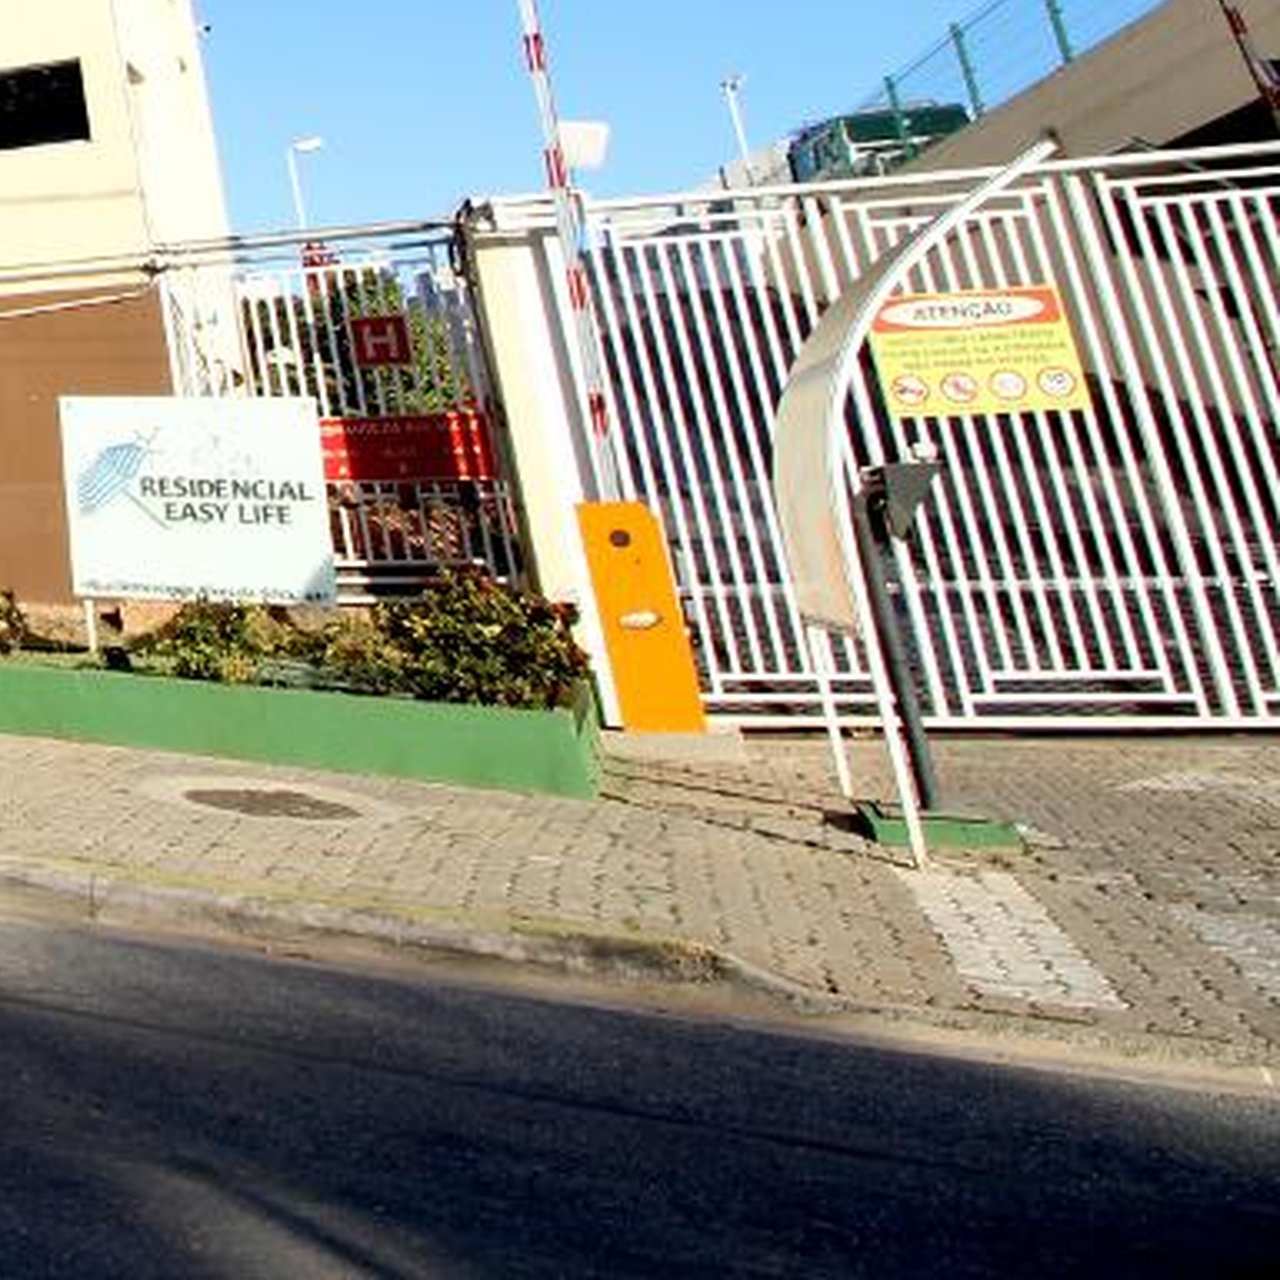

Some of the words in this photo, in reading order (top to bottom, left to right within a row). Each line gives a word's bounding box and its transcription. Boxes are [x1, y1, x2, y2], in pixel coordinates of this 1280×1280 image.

[140, 477, 315, 501] RESIDENCIAL
[164, 502, 229, 522] EASY
[239, 503, 292, 525] LIFE
